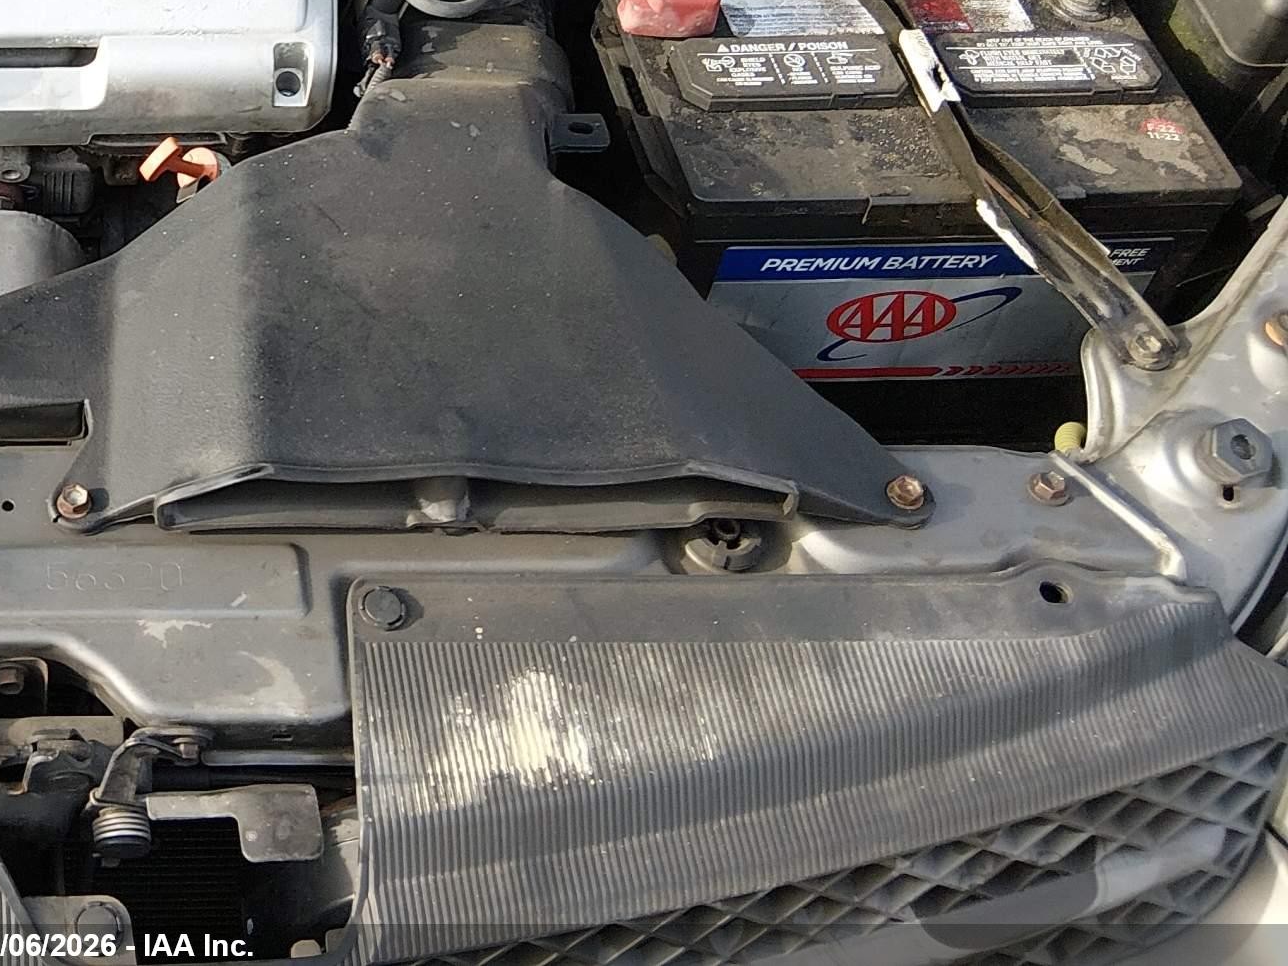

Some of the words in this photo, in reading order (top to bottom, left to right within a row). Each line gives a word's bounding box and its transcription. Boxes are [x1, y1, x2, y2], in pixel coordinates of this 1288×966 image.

[730, 43, 786, 52] DANGER
[798, 42, 848, 51] POISON
[1147, 132, 1181, 141] 11-22
[1110, 248, 1152, 258] FREE
[760, 256, 883, 273] PREMIUM
[881, 253, 1000, 271] BATTERY
[831, 291, 952, 342] AAA
